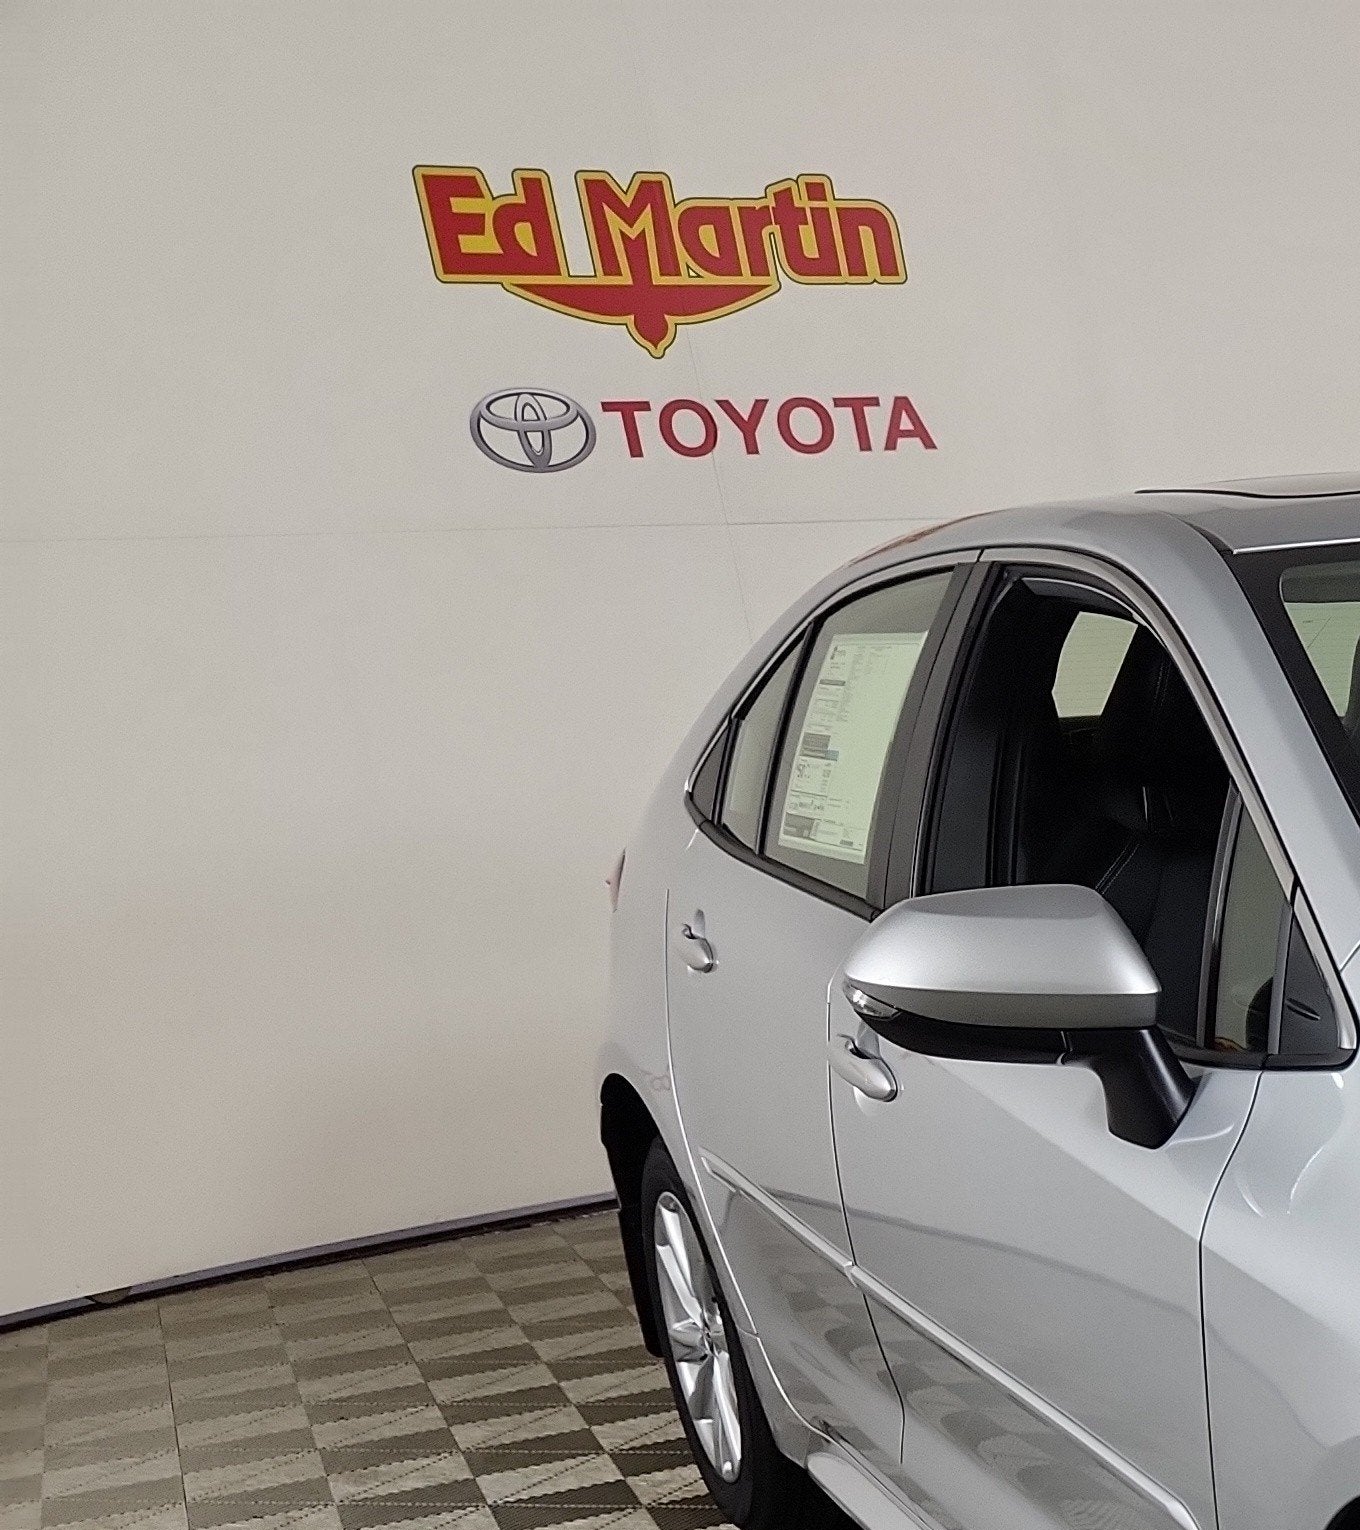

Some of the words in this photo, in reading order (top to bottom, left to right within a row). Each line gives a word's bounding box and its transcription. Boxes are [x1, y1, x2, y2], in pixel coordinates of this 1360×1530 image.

[419, 171, 563, 278] Ed
[582, 172, 902, 280] Martin
[601, 395, 938, 458] TOYOTA
